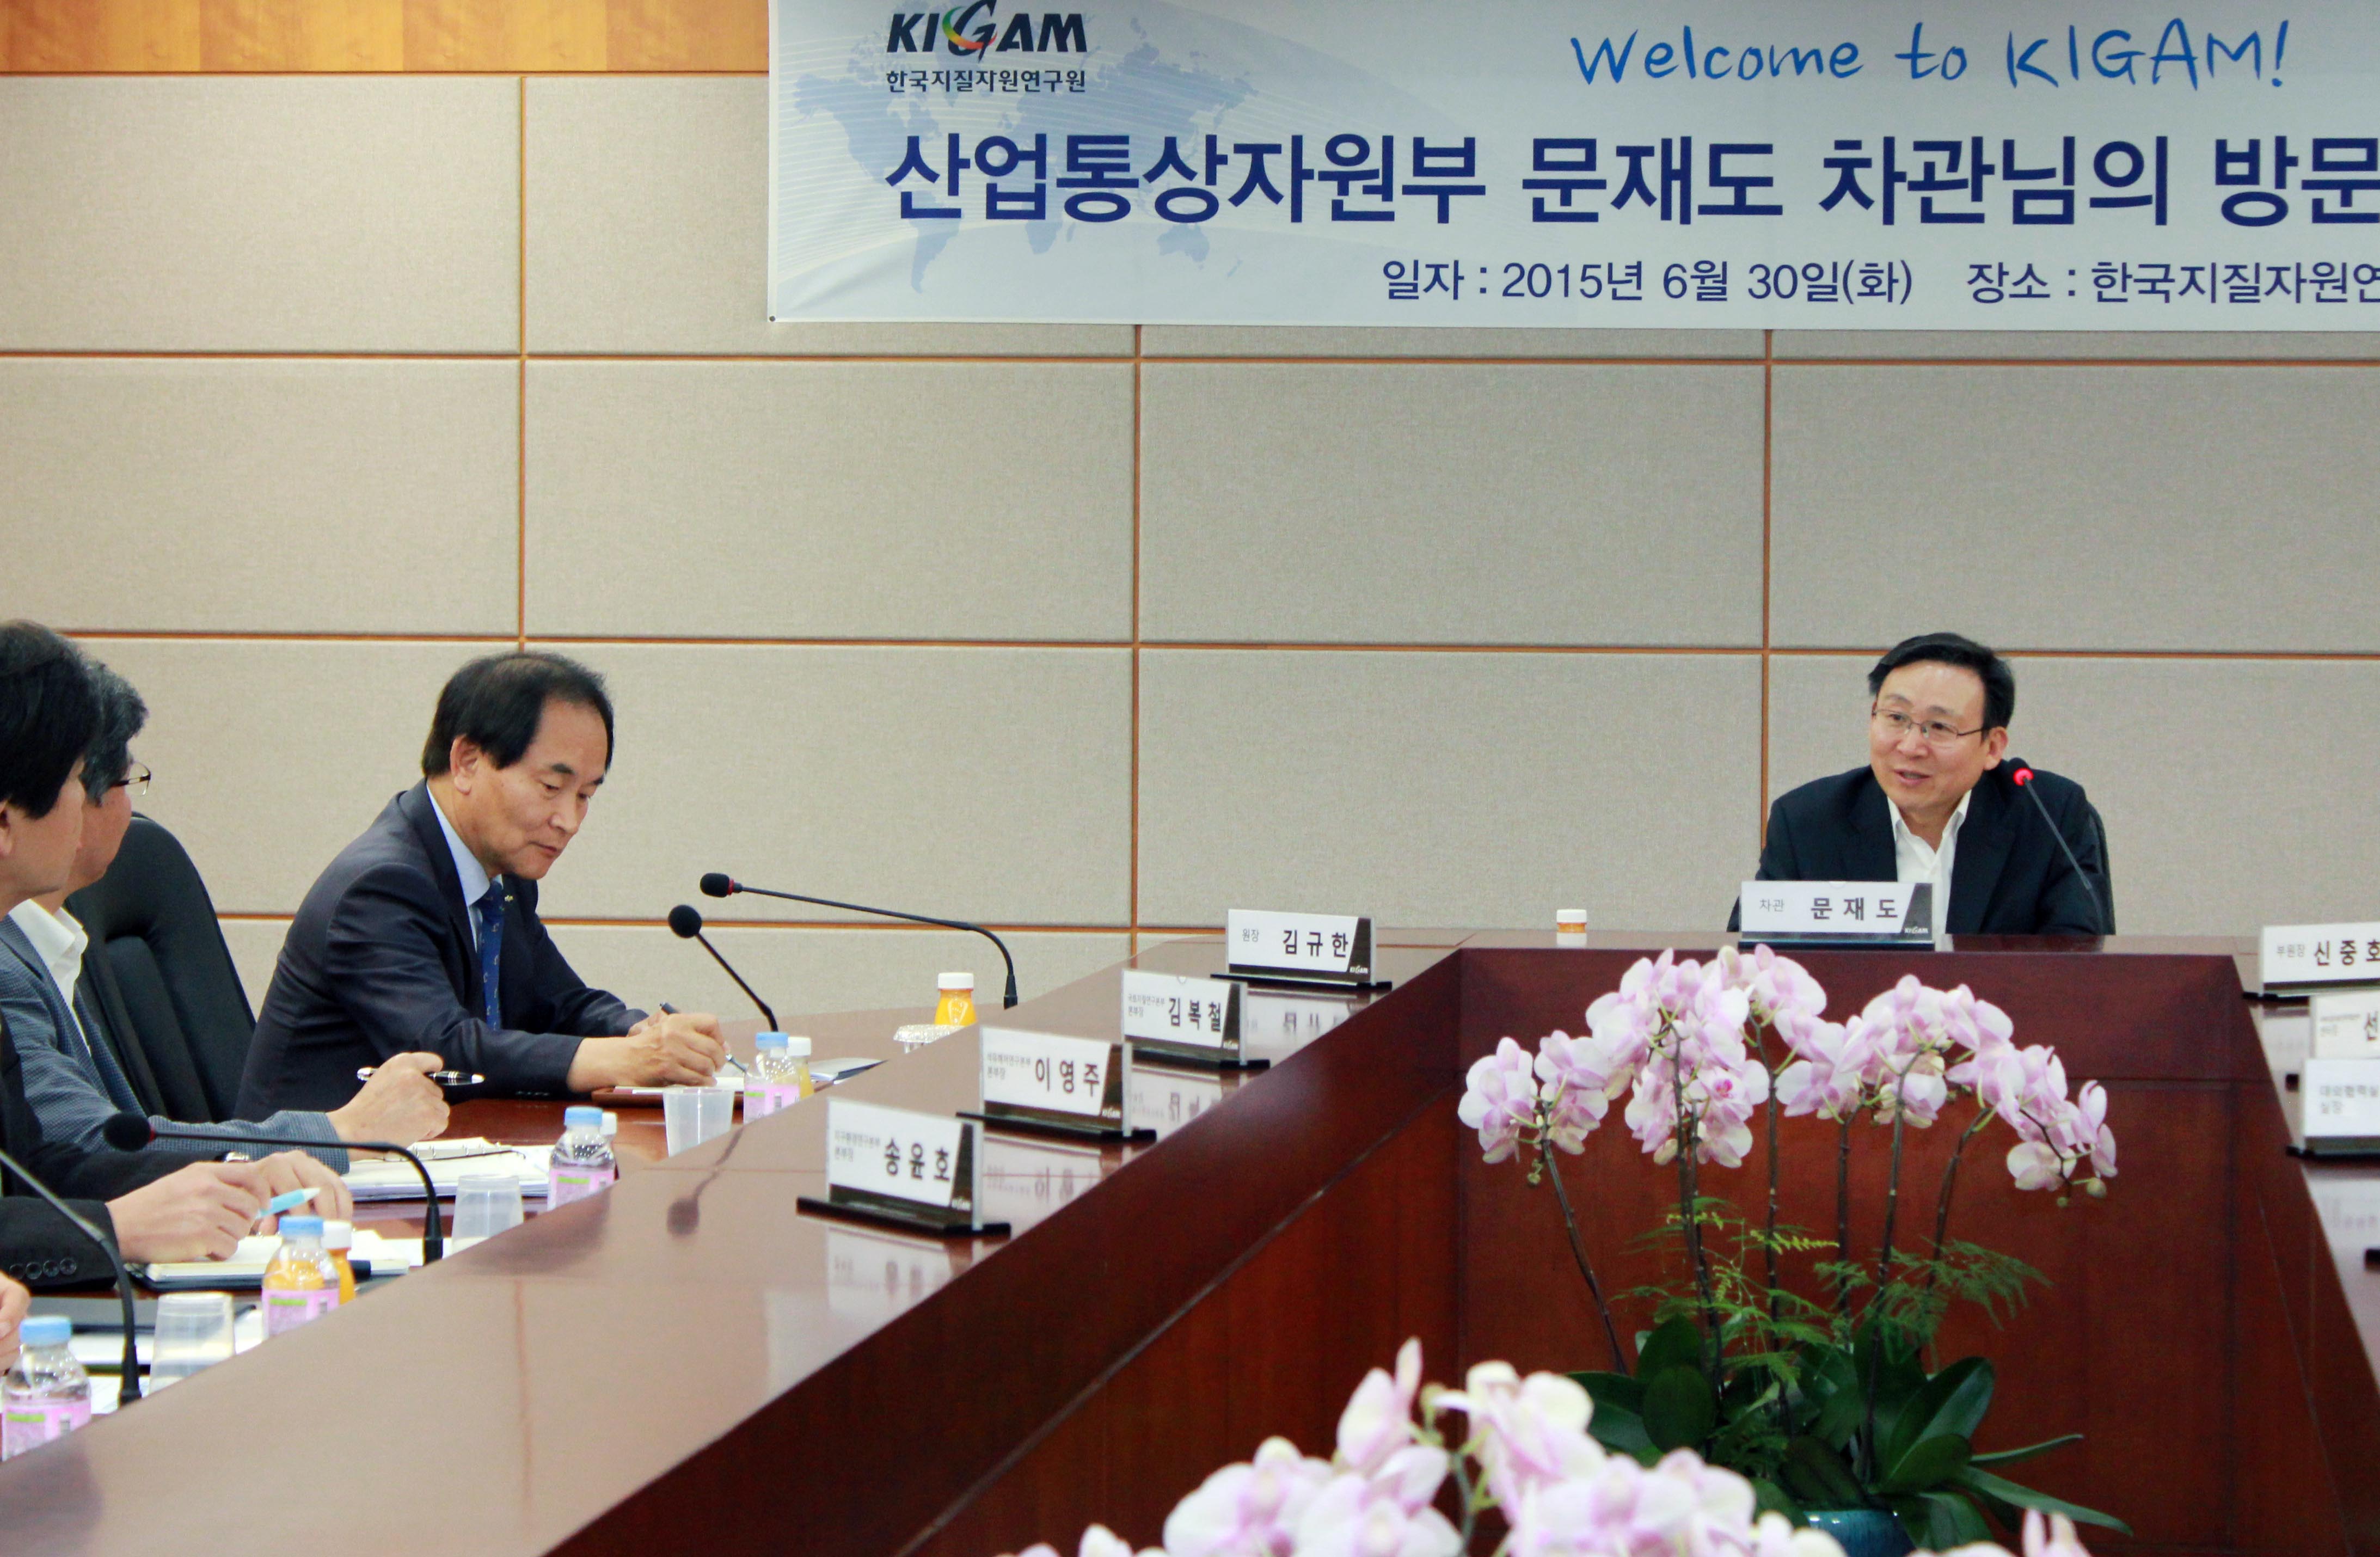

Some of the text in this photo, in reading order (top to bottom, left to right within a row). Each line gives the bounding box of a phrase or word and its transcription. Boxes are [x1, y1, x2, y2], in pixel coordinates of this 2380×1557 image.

[887, 0, 1088, 60] KIGAM
[1571, 18, 2289, 90] Welcome to KIGAM!
[886, 70, 1086, 94] 한국지질자원연구원
[886, 133, 2380, 228] 산업통상자원부 문재도 차관님의 방문
[1383, 260, 1466, 302] 일자
[1502, 261, 1643, 303] 2015년
[1664, 260, 1729, 303] 6월
[1748, 260, 1913, 306] 30일(화)
[1967, 262, 2052, 305] 장소
[1759, 897, 1899, 921] 차관 문재도
[1242, 928, 1349, 958] 원장 김규한
[1168, 997, 1222, 1032] 김복철
[1035, 1057, 1100, 1098] 이영주
[885, 1136, 950, 1182] 송윤호
